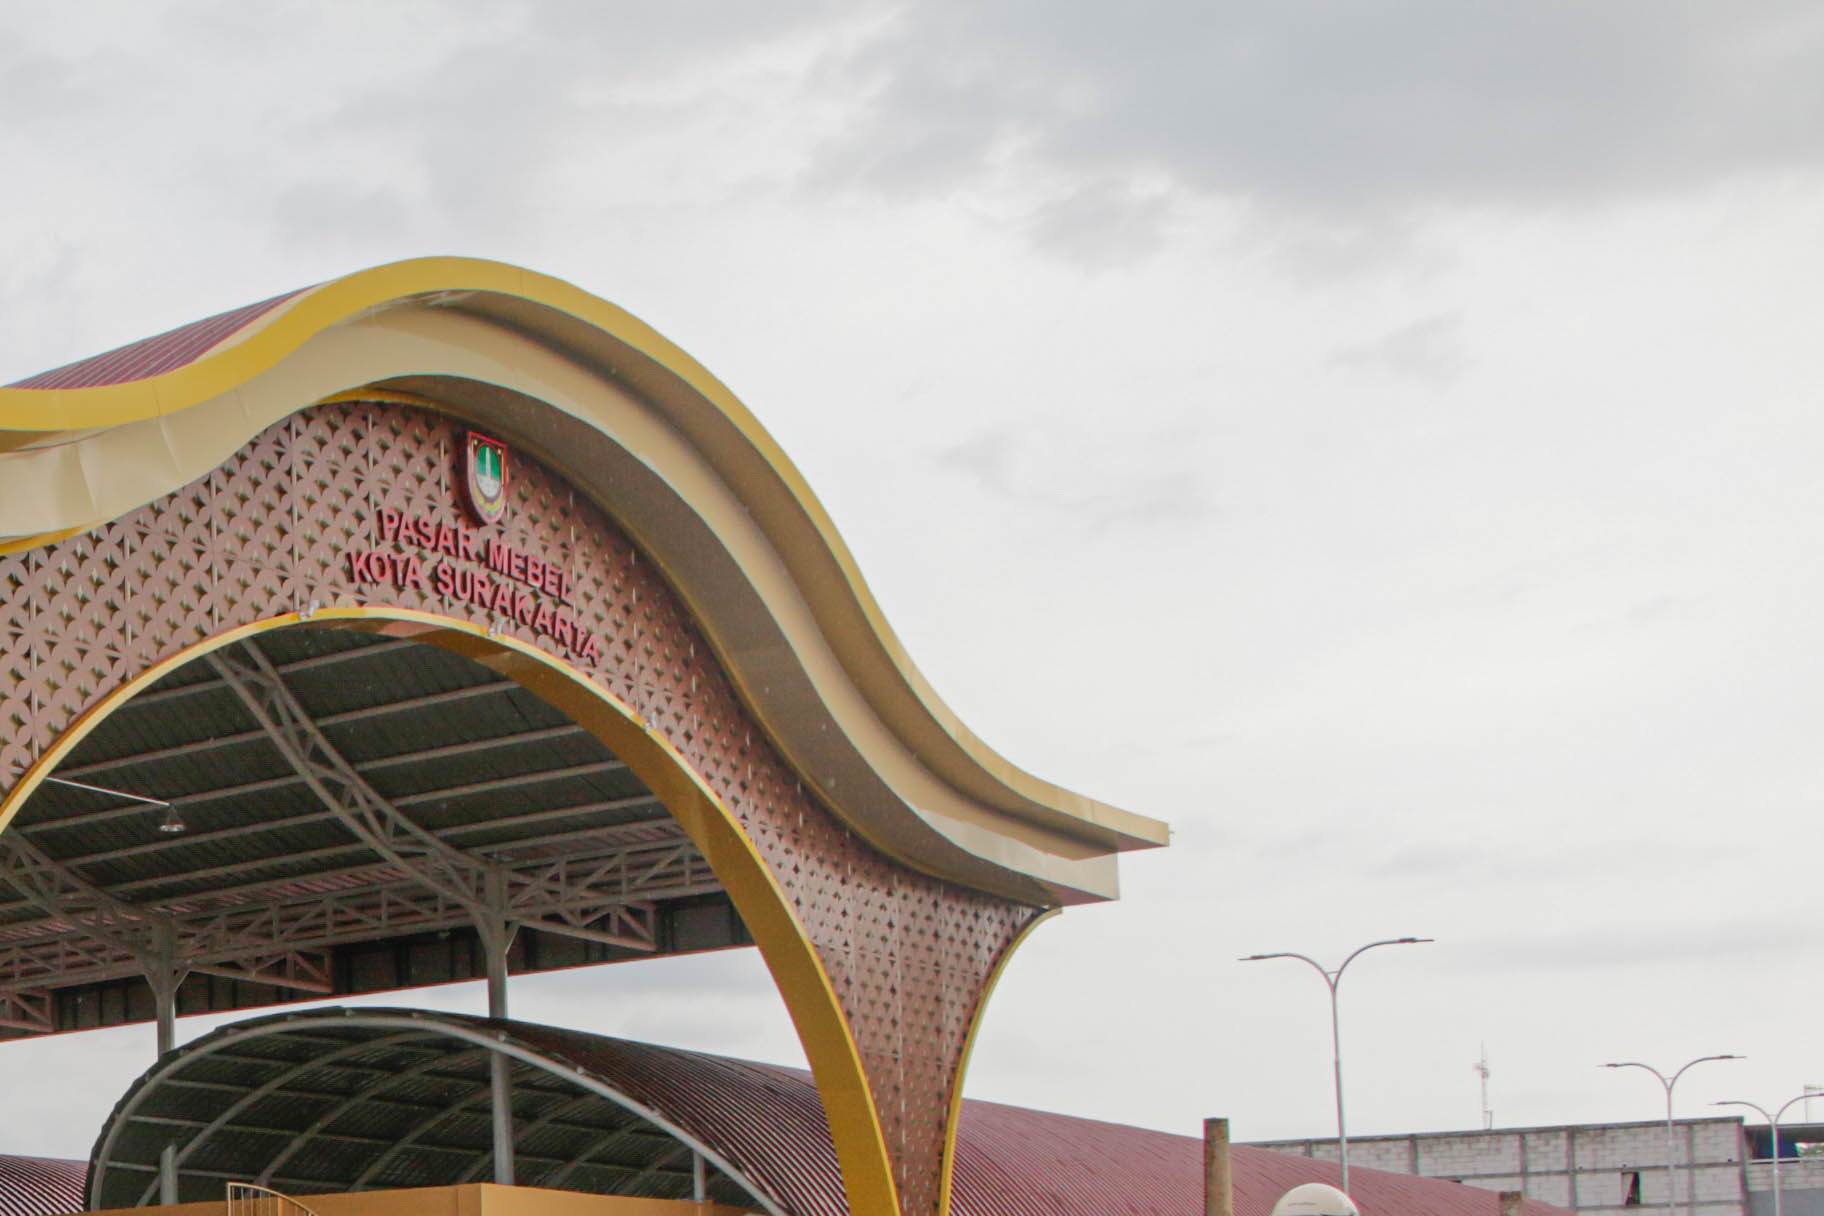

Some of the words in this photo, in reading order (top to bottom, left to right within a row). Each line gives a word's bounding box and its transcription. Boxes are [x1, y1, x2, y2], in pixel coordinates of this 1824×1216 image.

[348, 550, 424, 589] KOTA
[435, 562, 602, 666] SURAKARTA
[380, 506, 476, 560] PASAR
[488, 540, 575, 606] MEBEL
